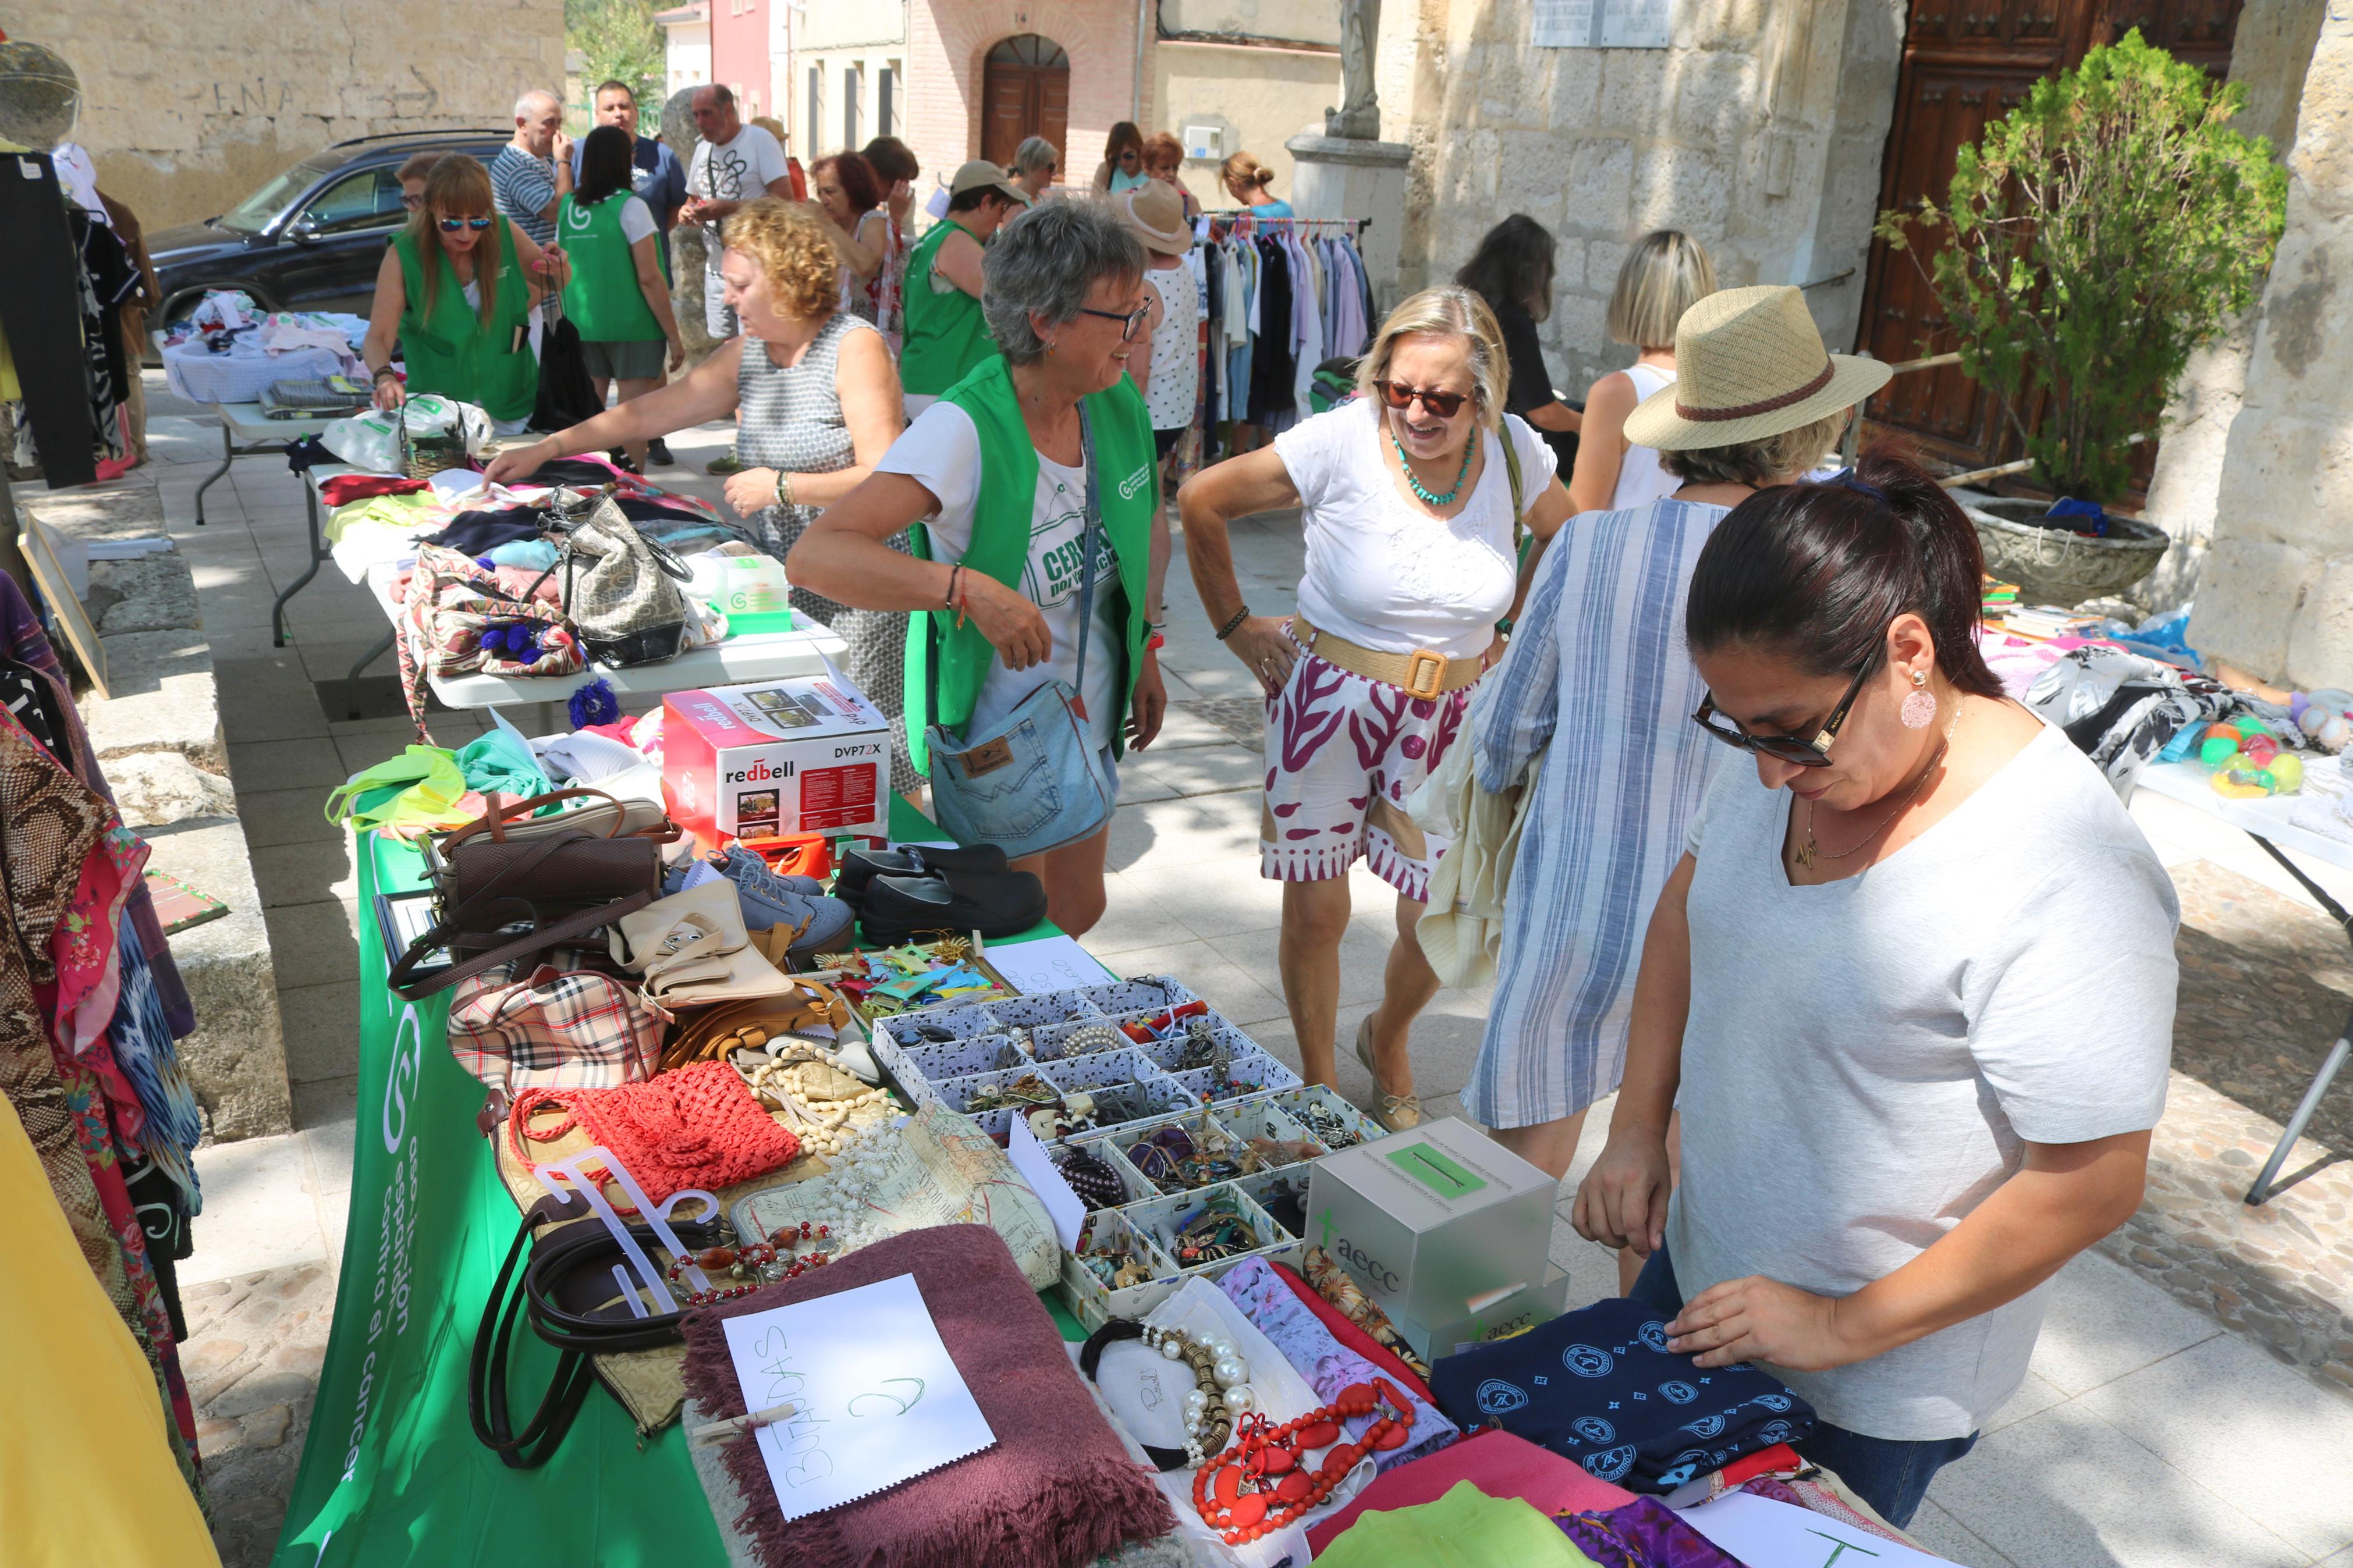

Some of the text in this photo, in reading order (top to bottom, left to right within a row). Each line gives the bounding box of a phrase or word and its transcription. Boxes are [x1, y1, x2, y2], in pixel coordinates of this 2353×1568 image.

[1050, 577, 1073, 598] por
[692, 702, 736, 730] redbell
[841, 712, 867, 726] dvd
[835, 744, 881, 758] DVP72X
[726, 758, 794, 783] redbell
[1361, 1150, 1387, 1169] Asociación
[1387, 1167, 1411, 1185] Española
[1410, 1182, 1428, 1197] Contra
[1337, 1238, 1399, 1292] aecc
[1344, 1263, 1362, 1278] Contra
[340, 1185, 392, 1484] contra el cáncer
[1488, 1312, 1531, 1341] aecc
